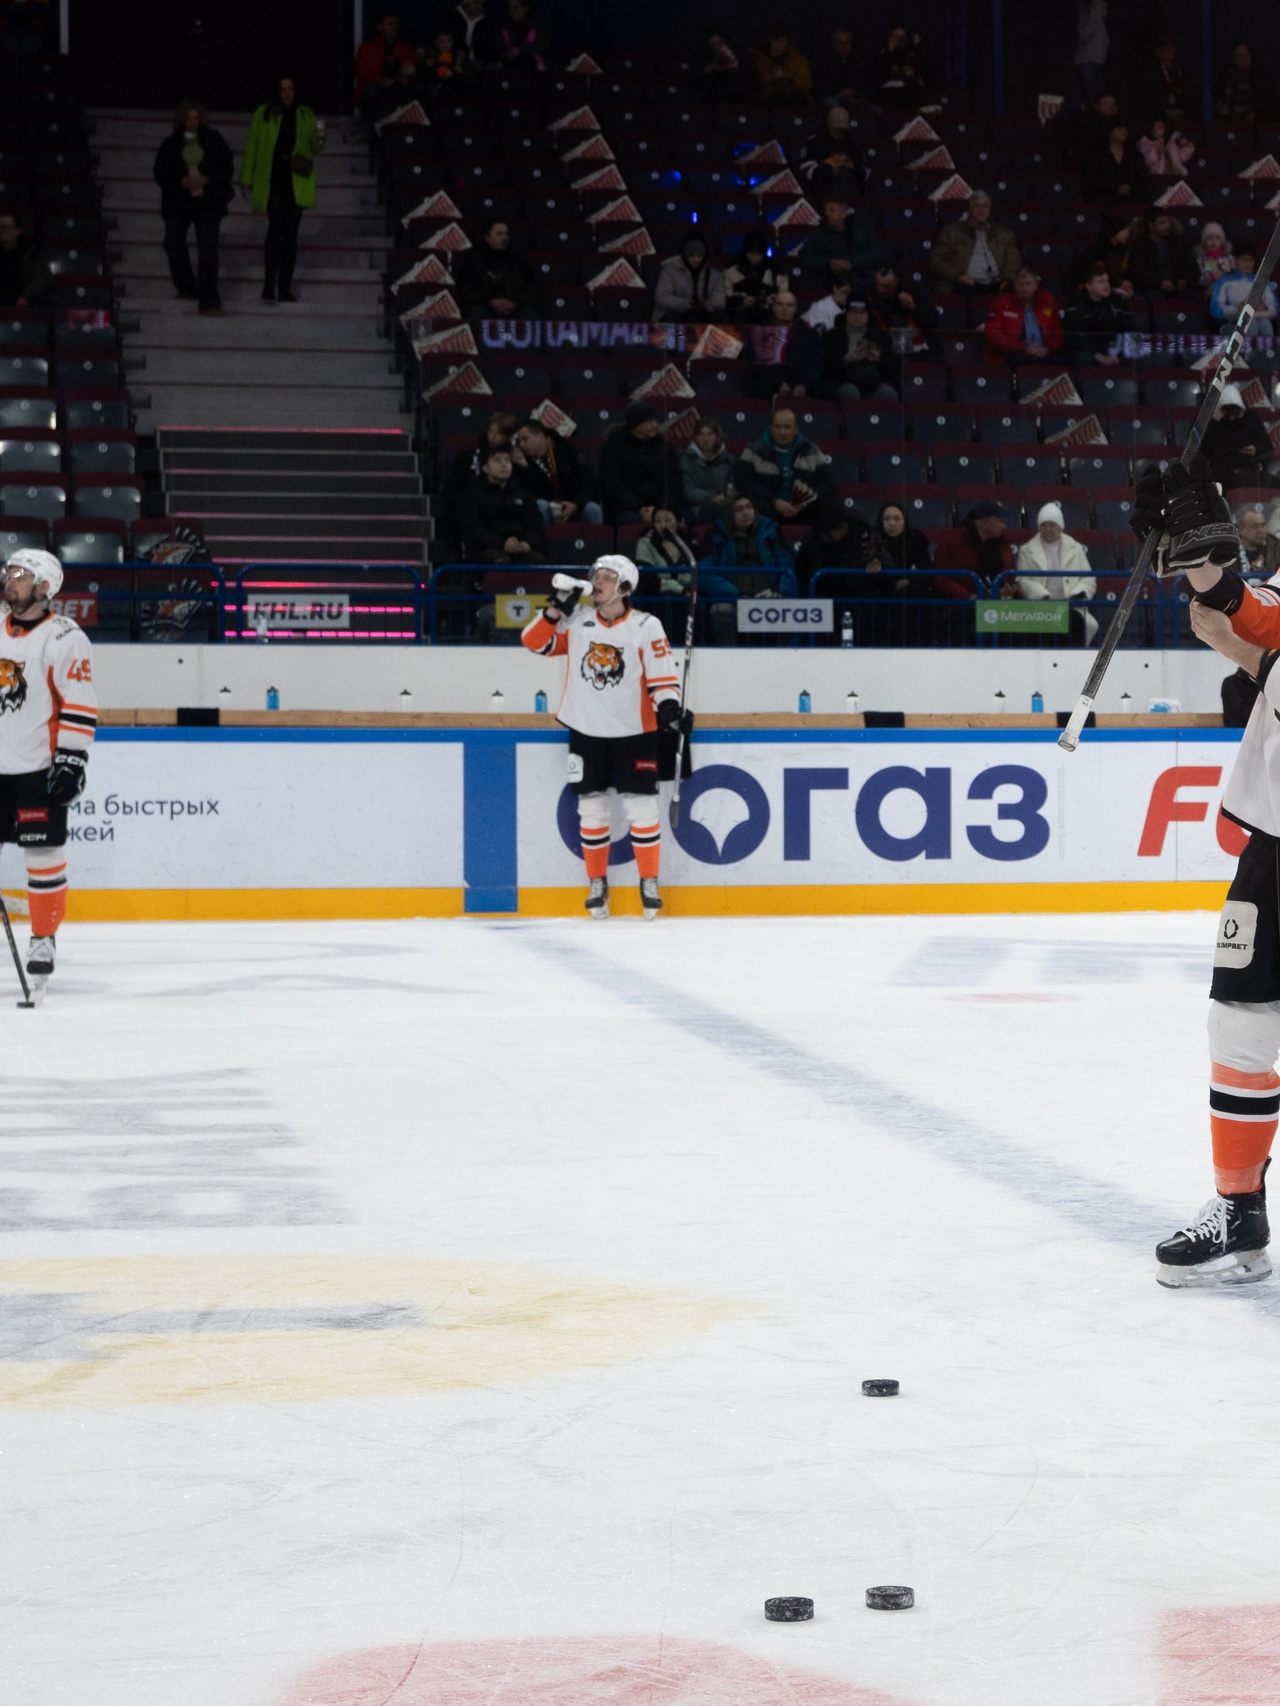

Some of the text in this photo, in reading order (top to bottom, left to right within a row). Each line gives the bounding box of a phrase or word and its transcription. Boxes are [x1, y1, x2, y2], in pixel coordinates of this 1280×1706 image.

[253, 602, 344, 620] KHL.RU
[748, 607, 824, 624] согаз
[104, 793, 219, 820] быстрых
